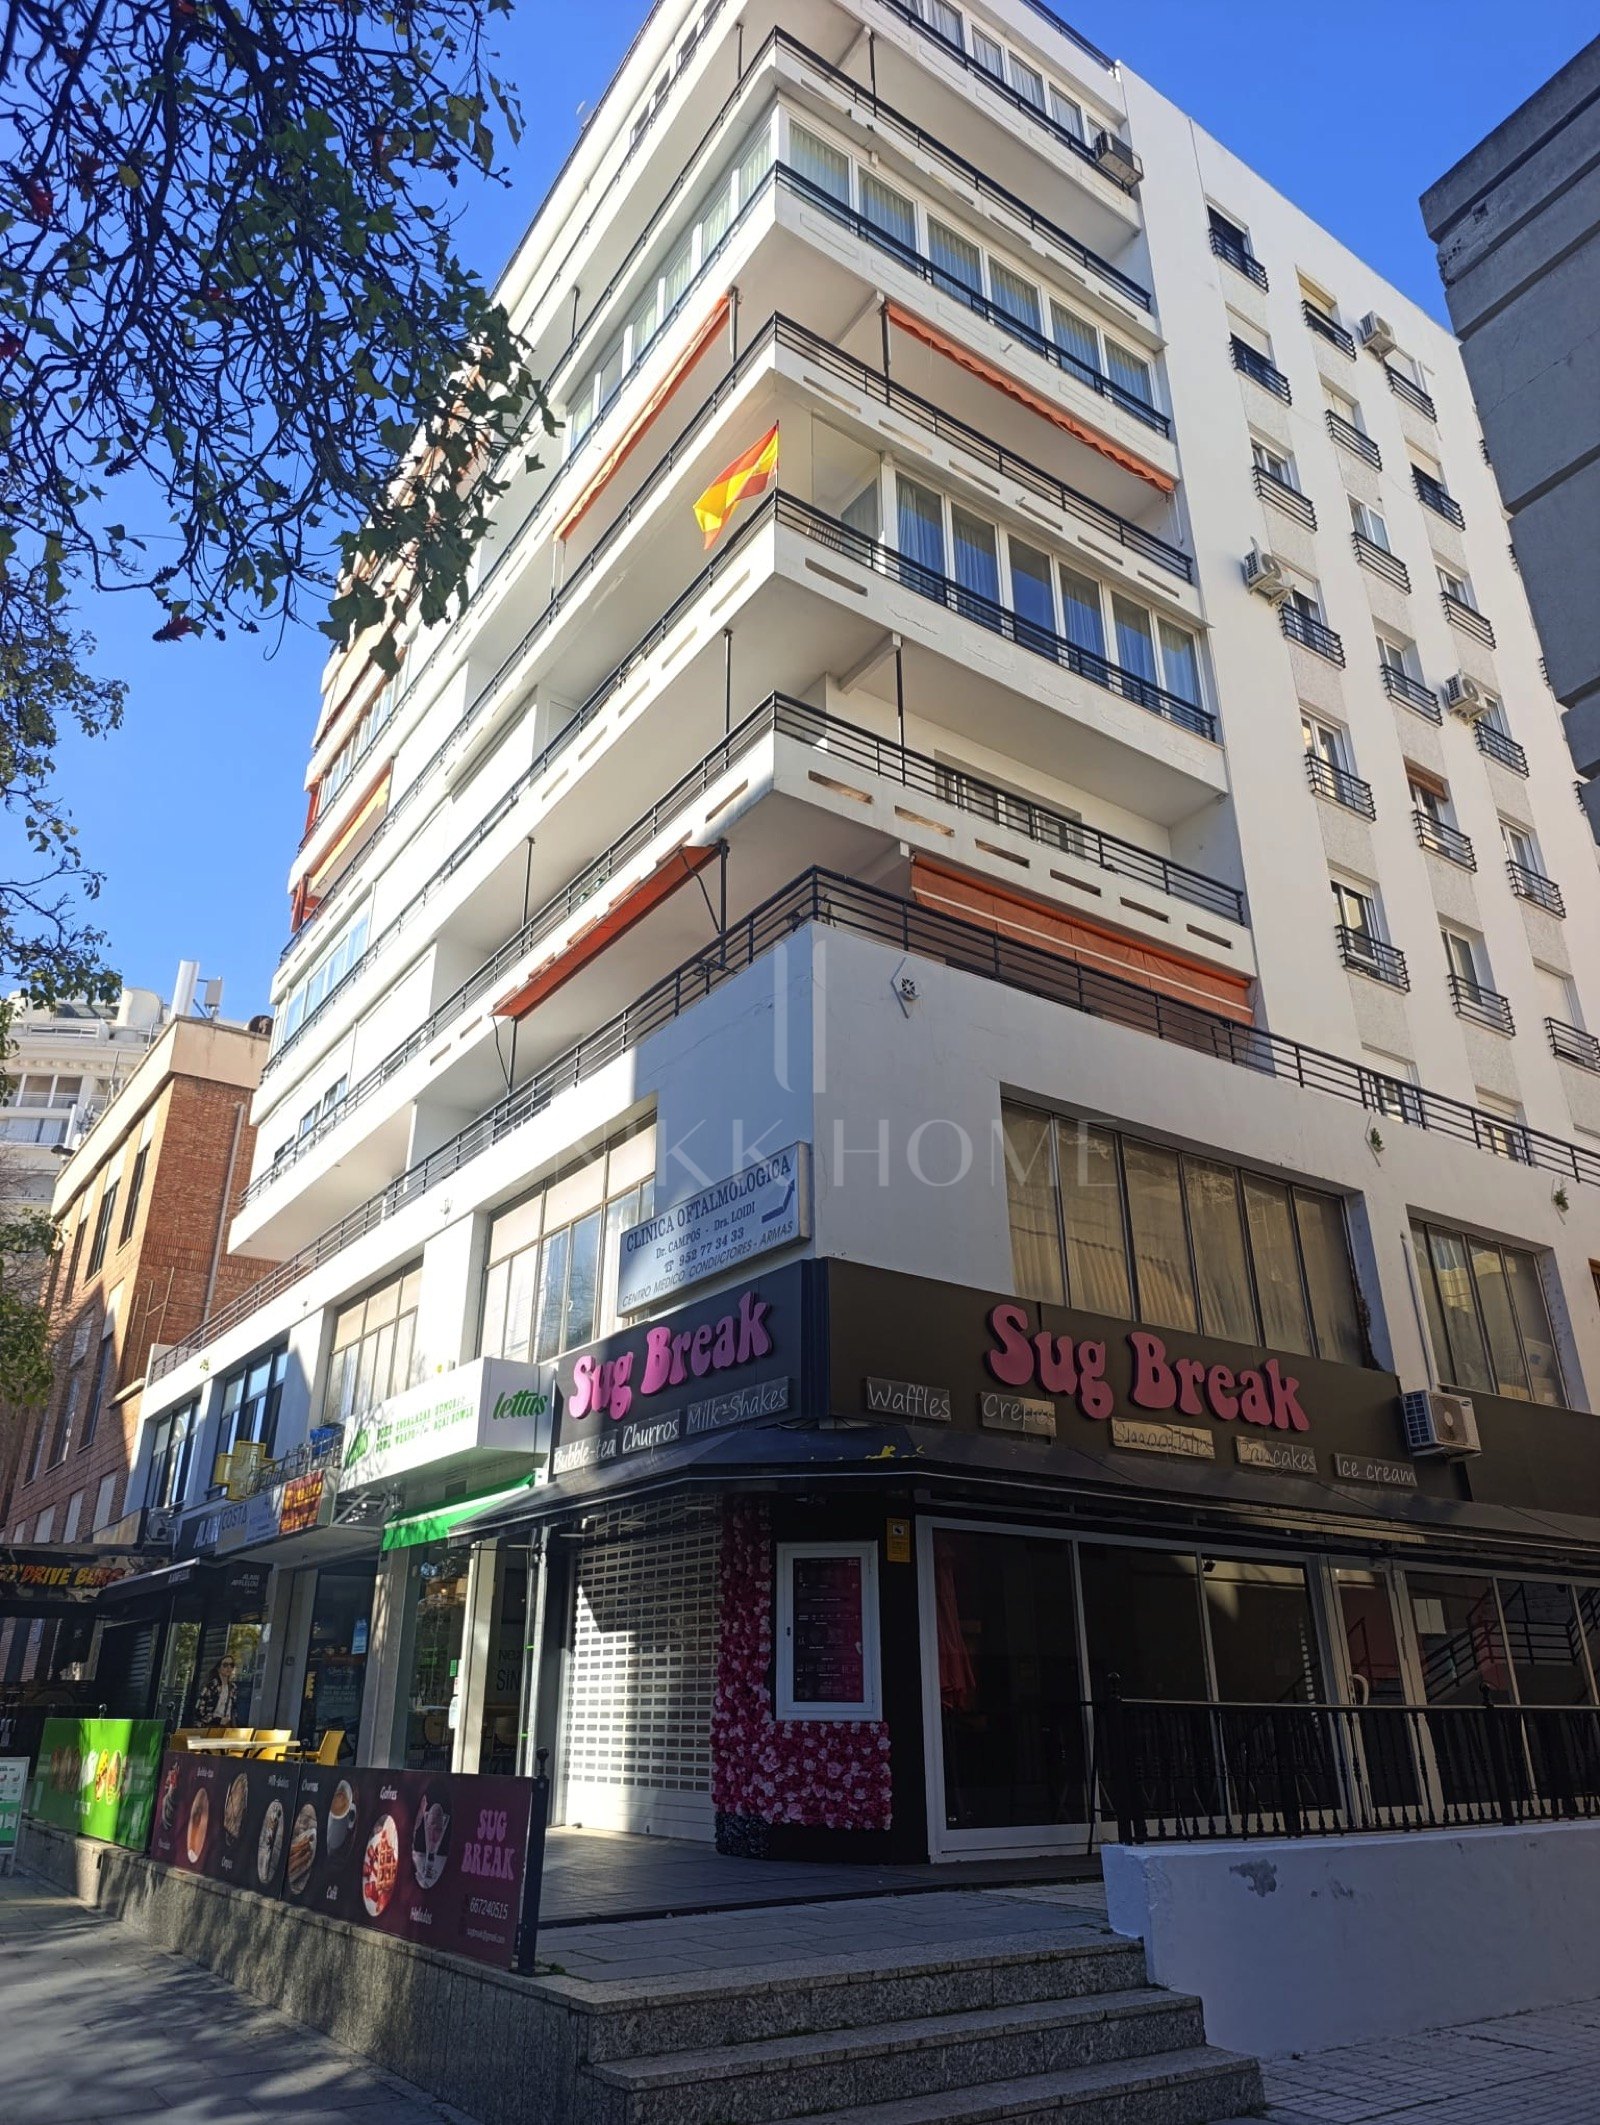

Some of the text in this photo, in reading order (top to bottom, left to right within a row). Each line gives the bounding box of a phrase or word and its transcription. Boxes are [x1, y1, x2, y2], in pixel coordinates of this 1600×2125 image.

[627, 1155, 791, 1252] CLINICA OFTALMOLOGICA
[669, 1228, 701, 1254] CAMPOS
[731, 1202, 756, 1223] LOIDI
[679, 1227, 744, 1267] 952 77 34 33
[622, 1221, 793, 1307] CENTRO MEDICO CONDUCTORES ARMAS
[568, 1291, 773, 1421] Sug Break
[985, 1303, 1311, 1431] Sug Break
[867, 1382, 950, 1418] Waffles
[623, 1417, 679, 1452] Churros
[1337, 1454, 1416, 1483] Ice cream
[20, 1564, 72, 1586] DRIVE
[476, 1808, 508, 1842] SUG
[460, 1842, 516, 1881] BREAK
